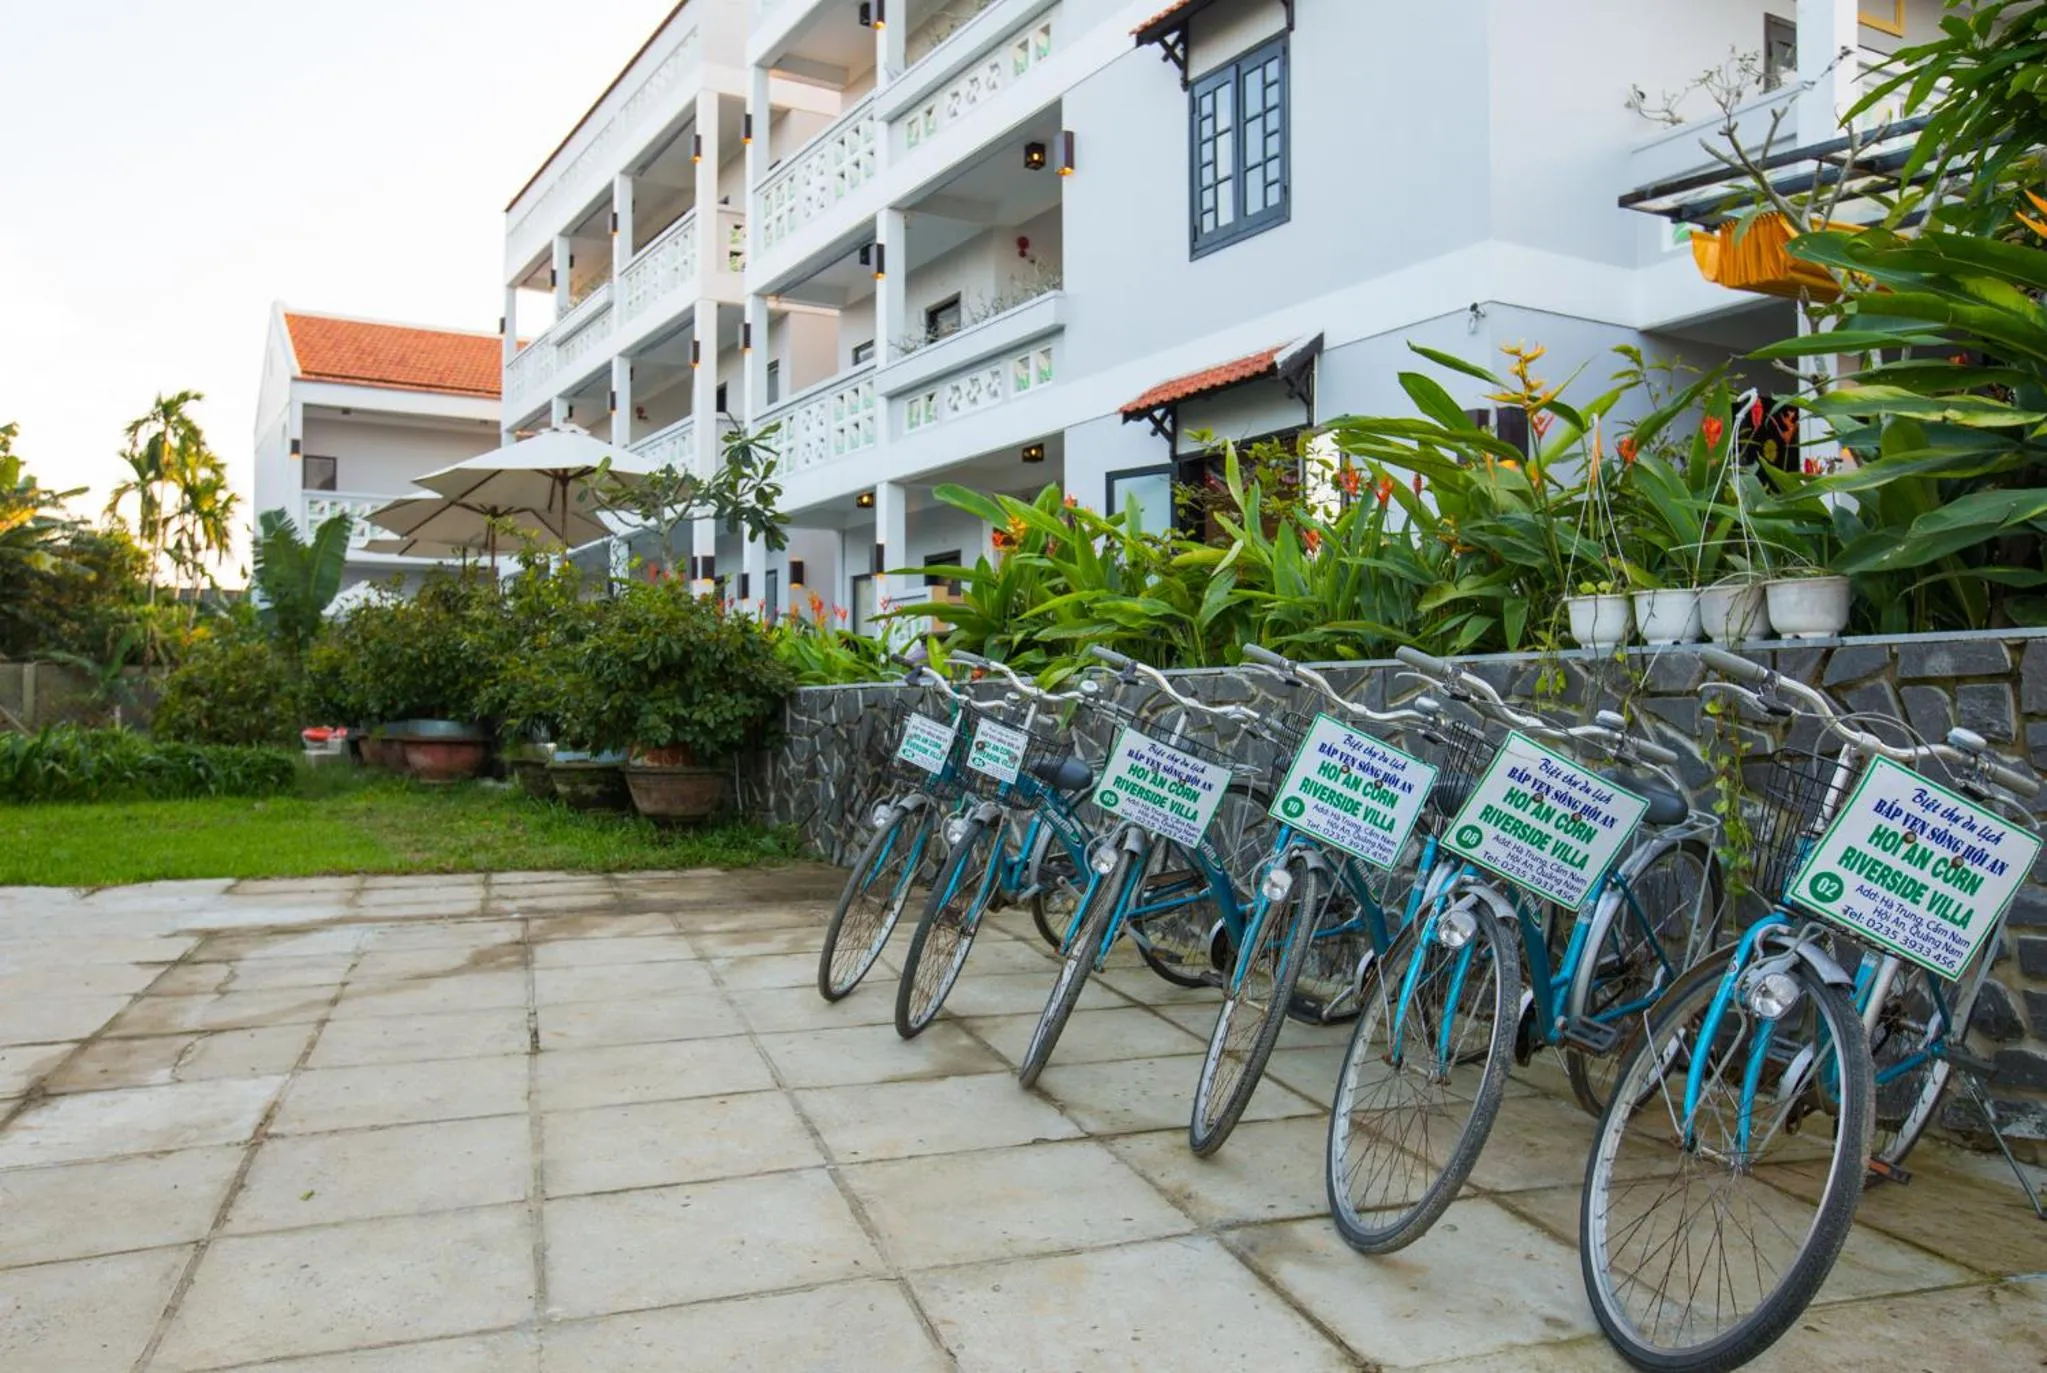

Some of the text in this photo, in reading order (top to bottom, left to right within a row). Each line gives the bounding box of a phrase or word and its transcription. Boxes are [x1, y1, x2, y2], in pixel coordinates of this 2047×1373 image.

[1113, 776, 1198, 822] RIVERSIDE VILLA
[1128, 764, 1201, 803] HOI AN CORN
[1299, 777, 1396, 834] RIVERSIDE VILLA
[1318, 761, 1399, 809] HOI AN CORN
[1531, 778, 1554, 796] VEN
[1551, 790, 1582, 811] SÔNG
[1577, 804, 1602, 822] HỘI
[1599, 815, 1618, 829] AN
[1462, 830, 1479, 845] 08
[1479, 805, 1590, 871] RIVERSIDE VILLA
[1503, 787, 1598, 844] HOI AN CORN
[1873, 799, 2009, 876] BẮP VEN SÔNG HỘI AN
[1912, 788, 2006, 846] Biệt thự du lịch
[1817, 878, 1839, 897] 02
[1838, 847, 1974, 930] RIVERSIDE VILLA
[1868, 824, 1984, 896] HOI AN CORN
[1856, 884, 1880, 902] Add:
[1879, 896, 1894, 910] Hà
[1896, 903, 1924, 929] Trung,
[1948, 932, 1971, 949] Nam
